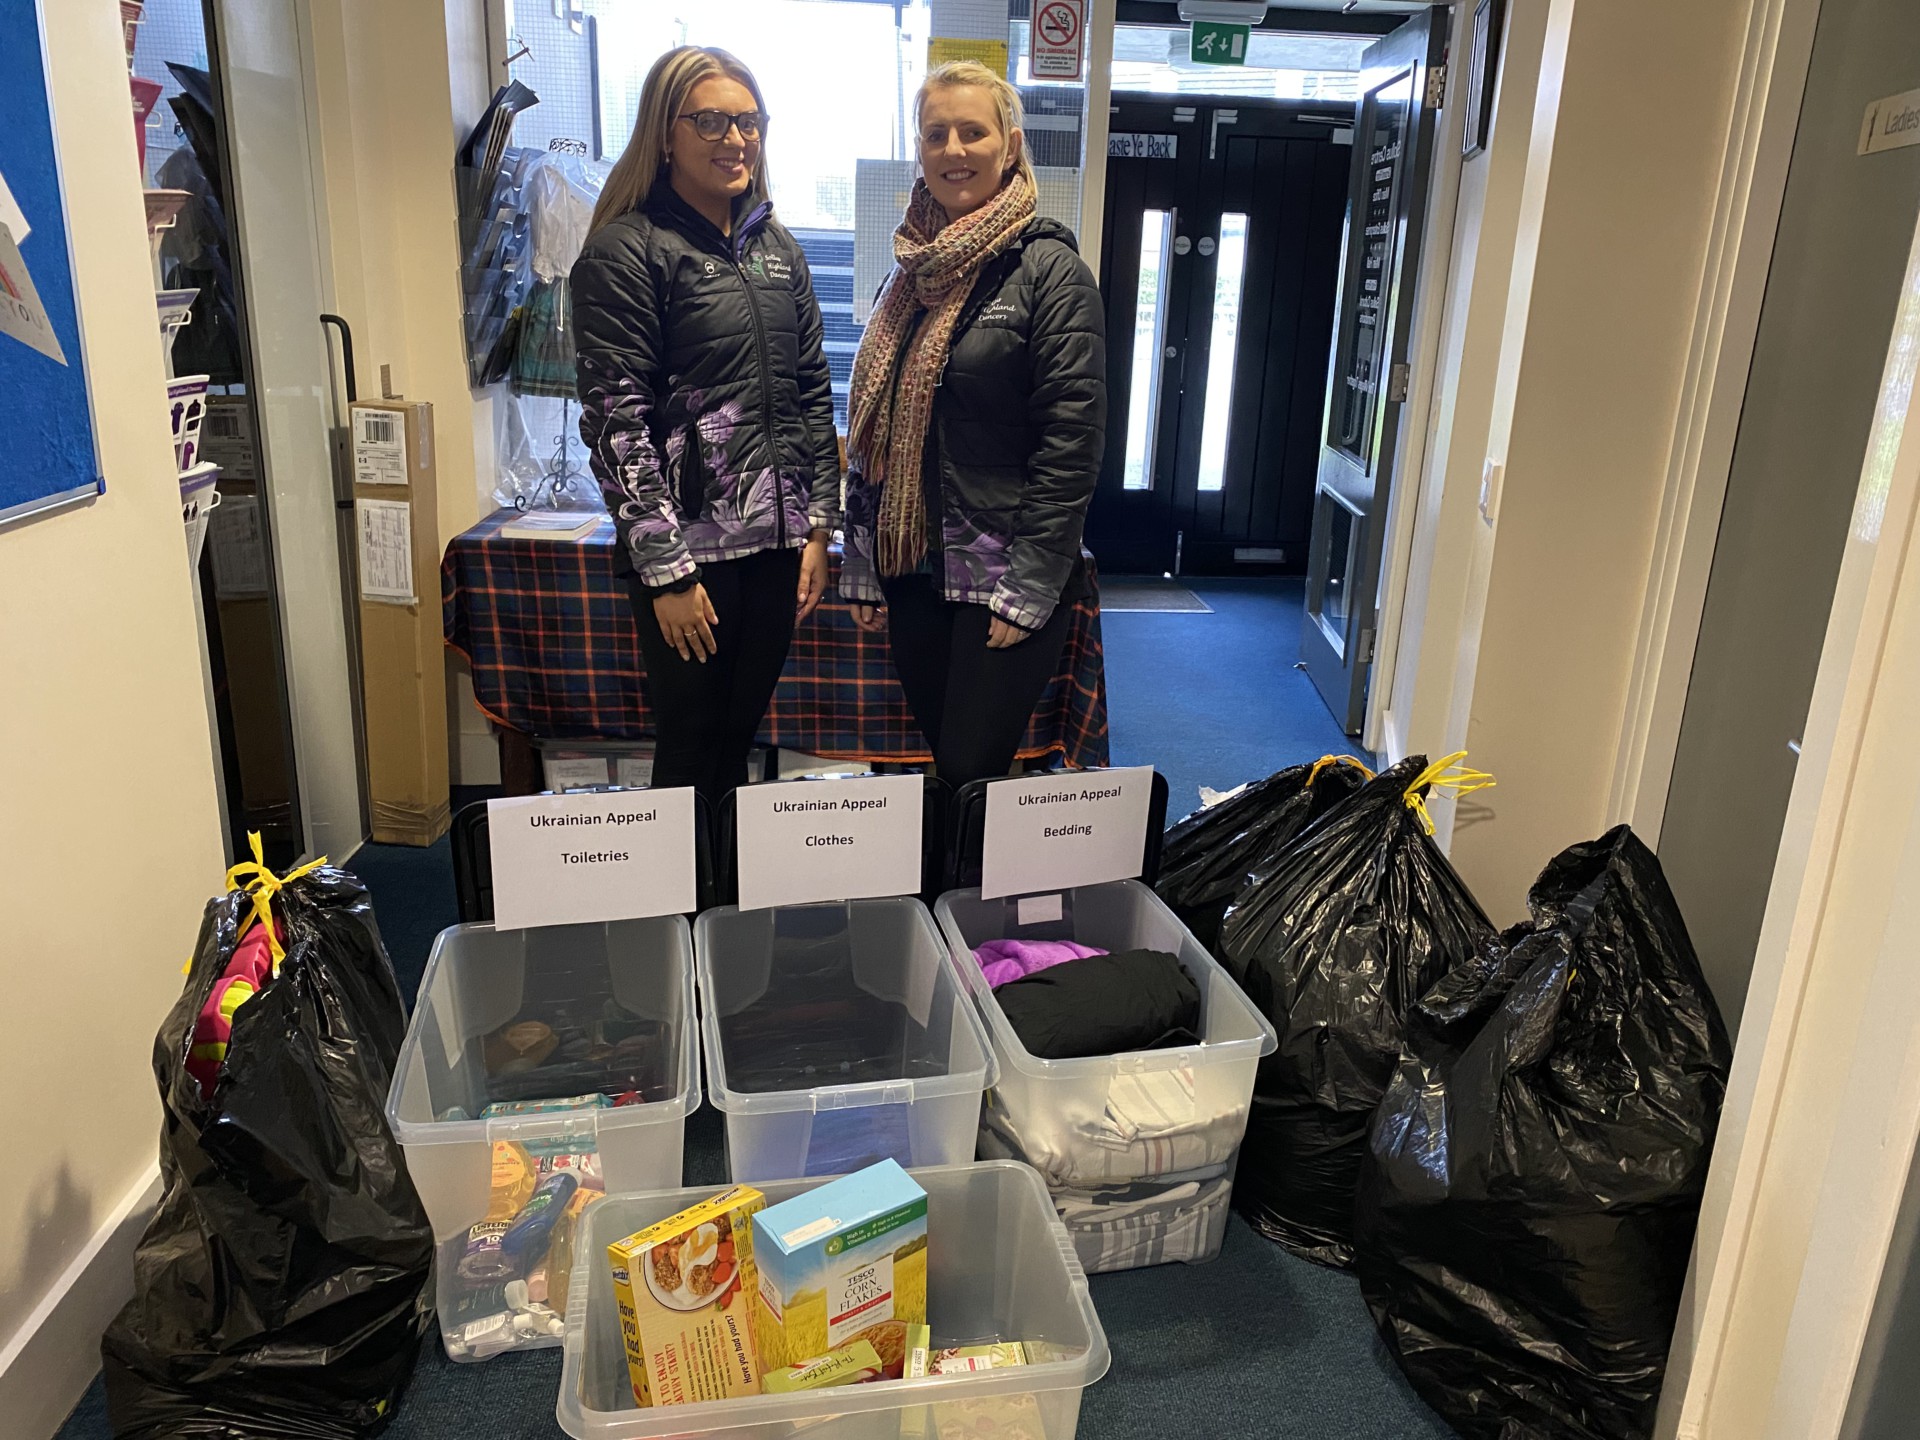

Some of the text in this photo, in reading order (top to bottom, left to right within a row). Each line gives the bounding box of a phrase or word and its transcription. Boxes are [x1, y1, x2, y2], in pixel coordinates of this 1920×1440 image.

[1885, 105, 1920, 135] Ladies
[1108, 134, 1171, 158] aste Ye Back
[767, 263, 791, 272] Highland
[769, 272, 790, 280] Dancers
[1018, 786, 1121, 806] Ukrainian Appeal
[773, 797, 887, 813] Ukrainian Appeal
[530, 809, 657, 827] Ukrainian Appeal
[1044, 824, 1092, 837] Bedding
[805, 834, 854, 847] Clothes
[561, 850, 629, 864] Toiletries
[471, 1221, 509, 1233] LISTERI
[847, 1268, 875, 1285] TESCO
[844, 1277, 877, 1299] CORN
[840, 1285, 882, 1312] FLAKES
[619, 1300, 635, 1320] Have
[622, 1319, 636, 1335] you
[626, 1335, 640, 1354] had
[726, 1315, 752, 1384] Have you had yours?
[628, 1355, 645, 1368] yours?
[654, 1353, 668, 1382] ENJOY
[664, 1343, 684, 1405] EALTHY START?
[659, 1383, 671, 1397] TO
